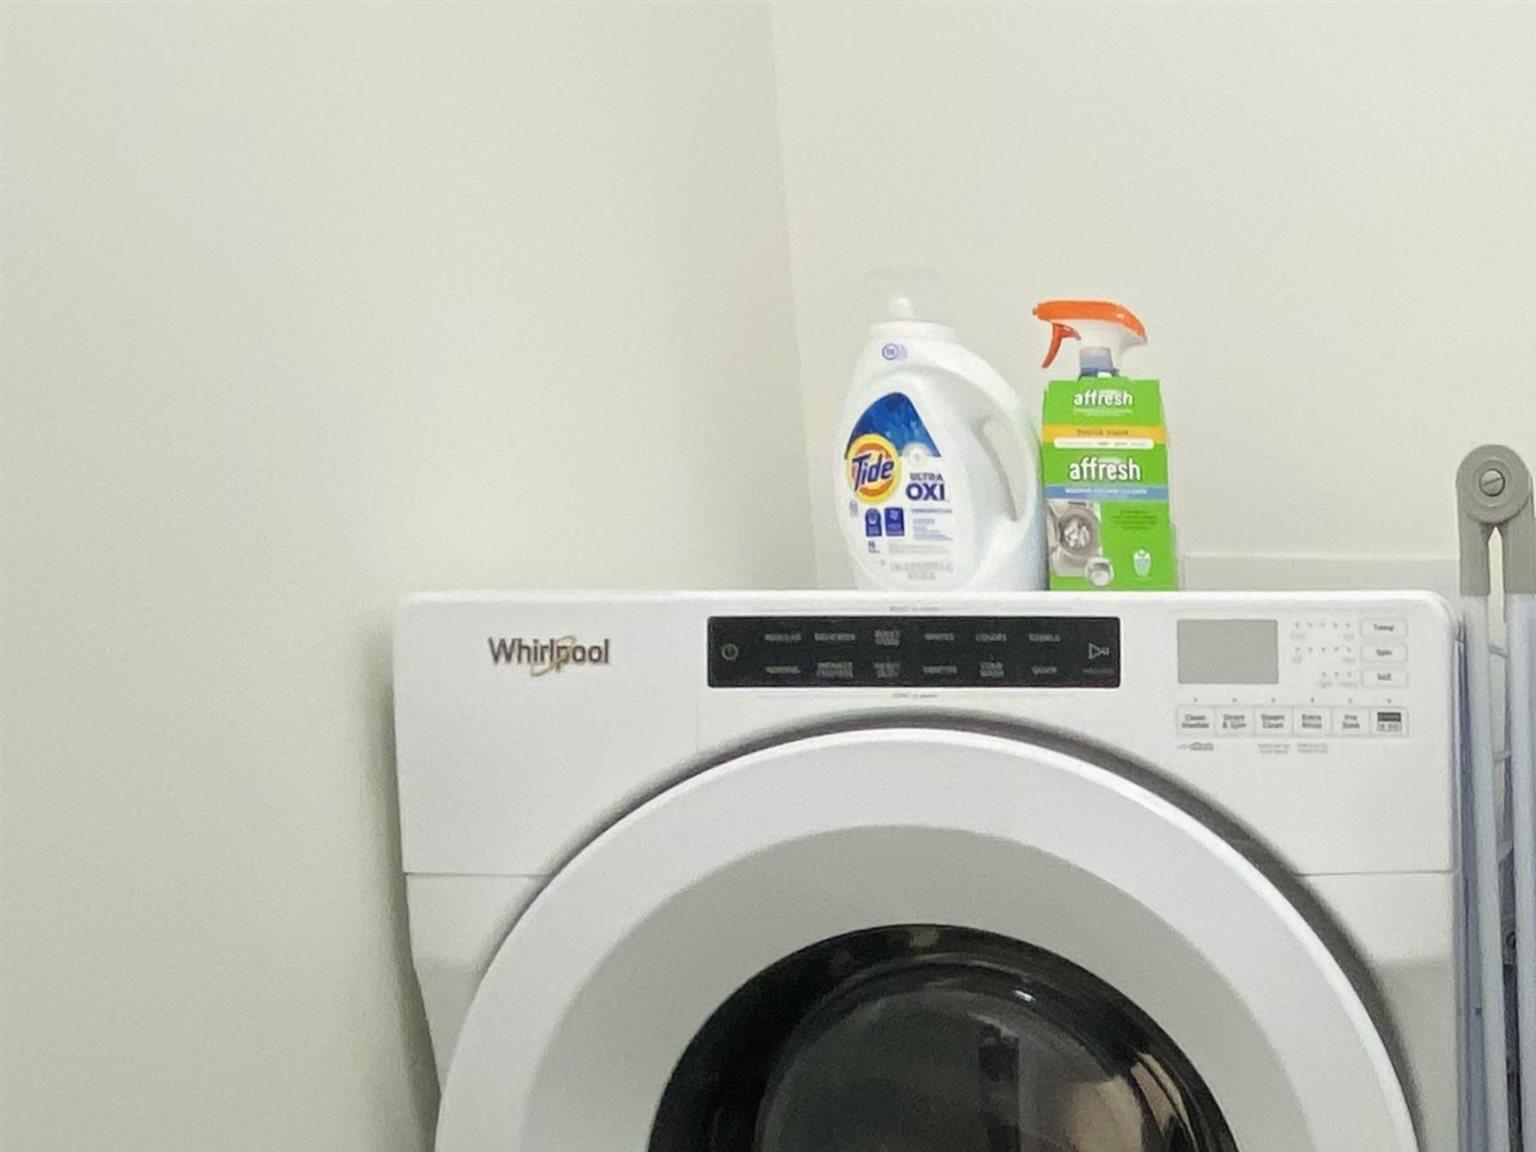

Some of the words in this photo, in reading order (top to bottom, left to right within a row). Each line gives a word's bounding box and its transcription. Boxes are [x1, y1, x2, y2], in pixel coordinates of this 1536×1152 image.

[1073, 389, 1134, 406] affresh
[852, 453, 895, 492] Tide
[909, 472, 944, 481] ULTRA
[1069, 457, 1142, 481] affresh
[905, 482, 945, 501] OXI
[488, 636, 611, 675] Whirlpool
